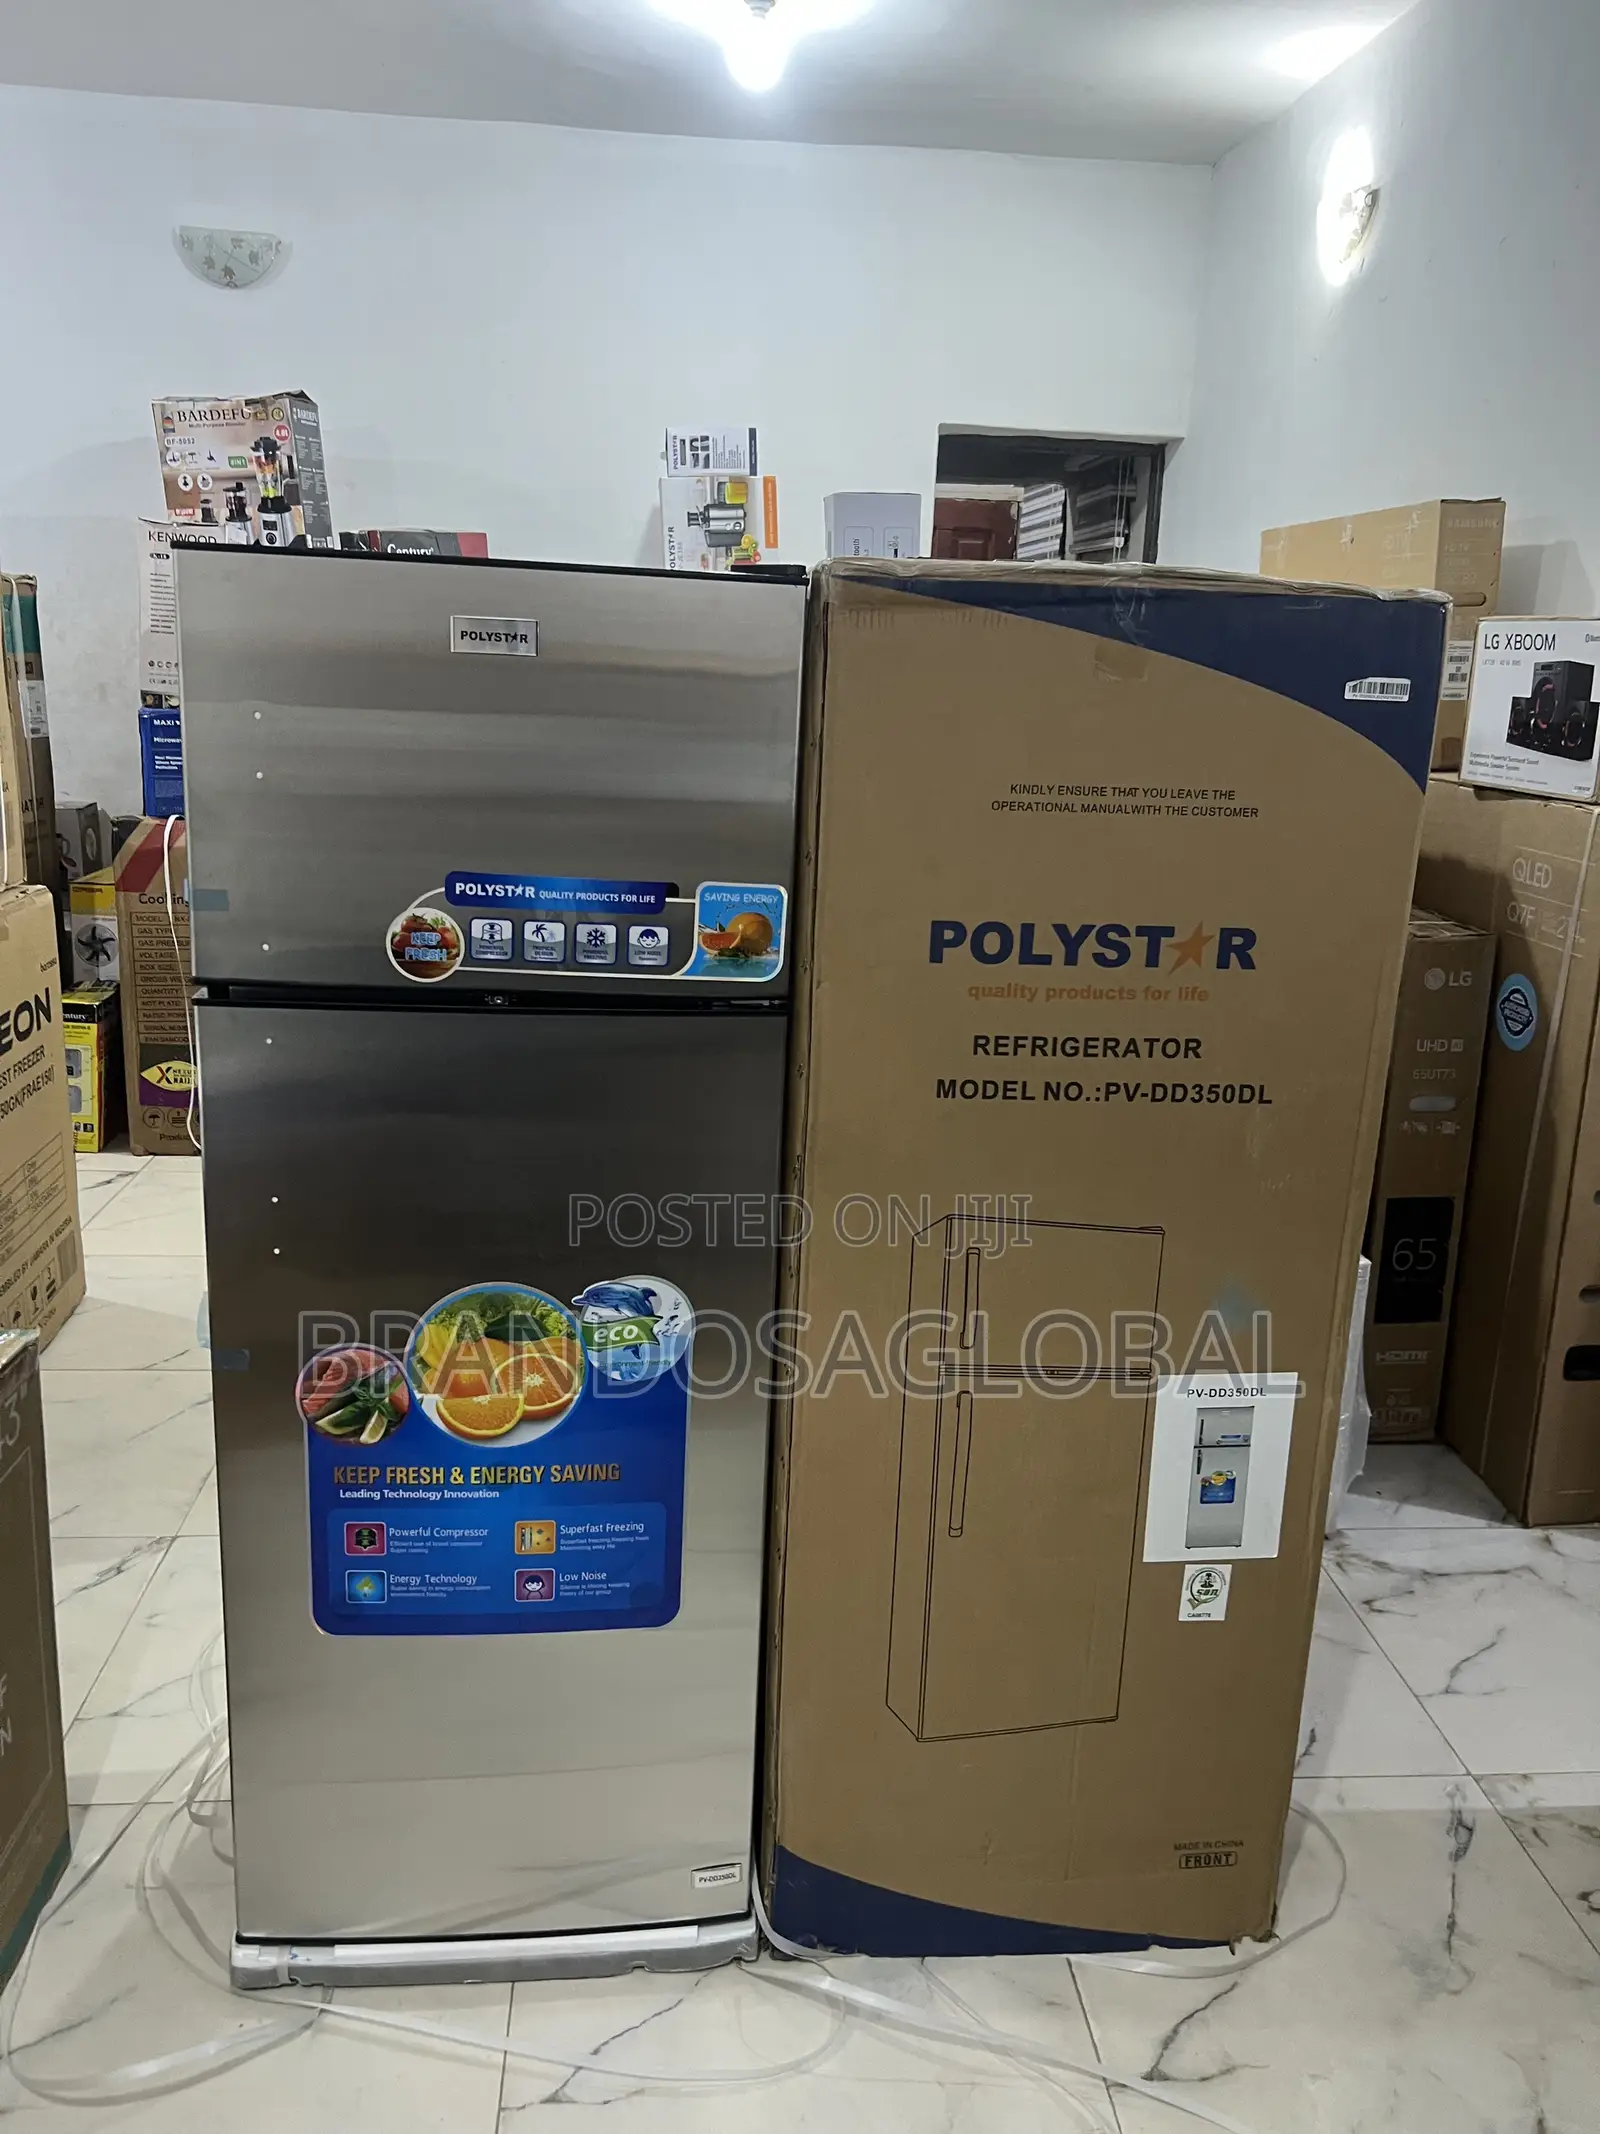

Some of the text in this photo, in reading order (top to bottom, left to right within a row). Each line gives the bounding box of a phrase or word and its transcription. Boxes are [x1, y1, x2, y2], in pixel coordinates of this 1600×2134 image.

[1484, 633, 1556, 651] LG XBOOM
[1009, 783, 1236, 801] KINDLY ENSURE THAT YOU LEAVE THE
[990, 800, 1078, 813] OPERATIONAL
[1164, 804, 1189, 816] THE
[1190, 805, 1259, 818] CUSTOMER
[1512, 857, 1552, 889] QLED
[539, 890, 574, 900] QUALITY
[575, 892, 619, 903] PRODUCTS
[620, 893, 637, 903] FOR
[639, 894, 656, 904] LIFE
[703, 891, 780, 905] SAVING ENERGY
[410, 932, 442, 945] KEEP
[1449, 971, 1473, 986] LG
[967, 982, 1210, 1003] quality products for life
[972, 1034, 1203, 1059] REFRIGERATOR
[1416, 1038, 1448, 1052] UHD
[13, 1044, 46, 1080] FREEZER
[935, 1078, 1036, 1101] MODEL
[1392, 1238, 1437, 1271] 65
[593, 1324, 639, 1344] eco
[1186, 1386, 1267, 1399] PV-DD350DL
[333, 1463, 621, 1485] KEEP FRESH & ENERGY SAVING
[339, 1488, 500, 1501] Leading Technology Innovation
[388, 1527, 489, 1539] Powerful Compressor
[560, 1521, 645, 1536] Superfast Freezing
[389, 1573, 478, 1586] Energy Technology
[559, 1571, 607, 1582] Low Noise
[1173, 1840, 1244, 1851] MADE IN CHINA
[1184, 1853, 1233, 1868] FRONT
